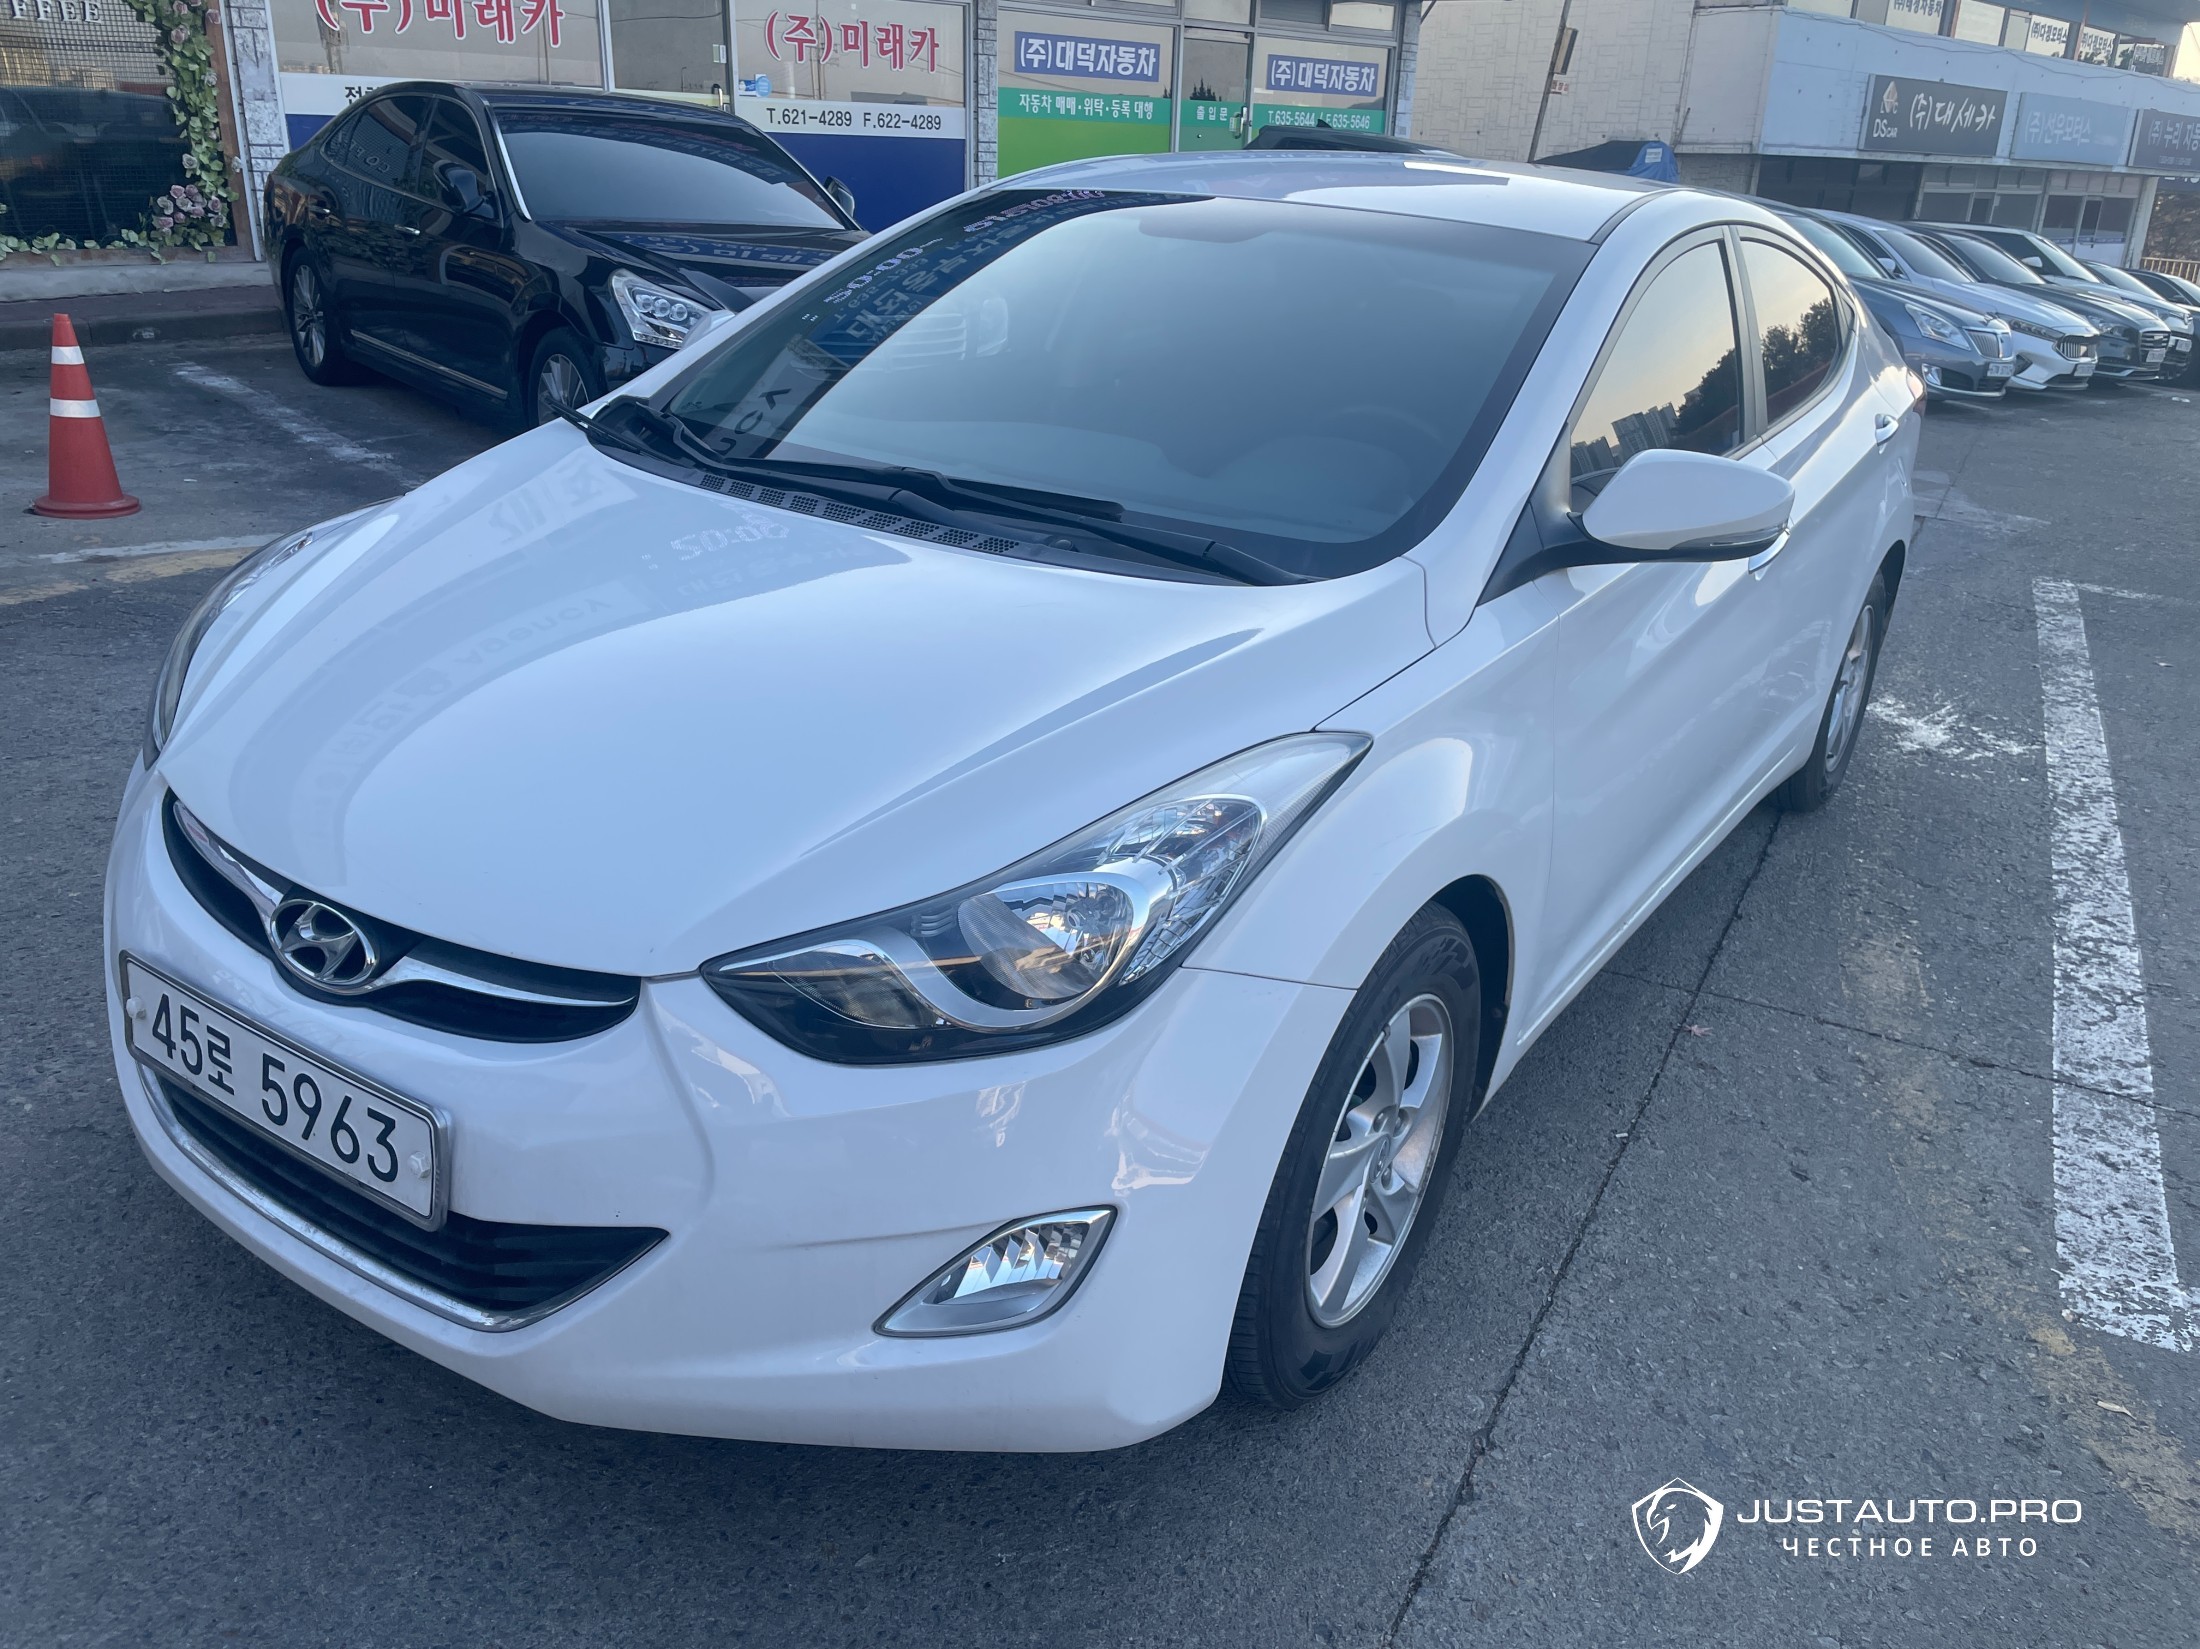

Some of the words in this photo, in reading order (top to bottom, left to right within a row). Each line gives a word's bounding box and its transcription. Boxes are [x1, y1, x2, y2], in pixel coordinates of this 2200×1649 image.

[765, 9, 940, 73] (주)미래카
[1018, 36, 1156, 77] (주)대덕자동차
[1270, 58, 1376, 93] (주)대덕자동차
[766, 107, 853, 128] T.621-4289
[862, 112, 942, 131] F.622-4289
[1019, 93, 1052, 114] 자동차
[1134, 101, 1154, 120] 대행
[1268, 110, 1315, 126] T.635-5644
[1909, 92, 1996, 133] (주)대세카
[151, 993, 235, 1096] 45로
[261, 1052, 399, 1183] 5963
